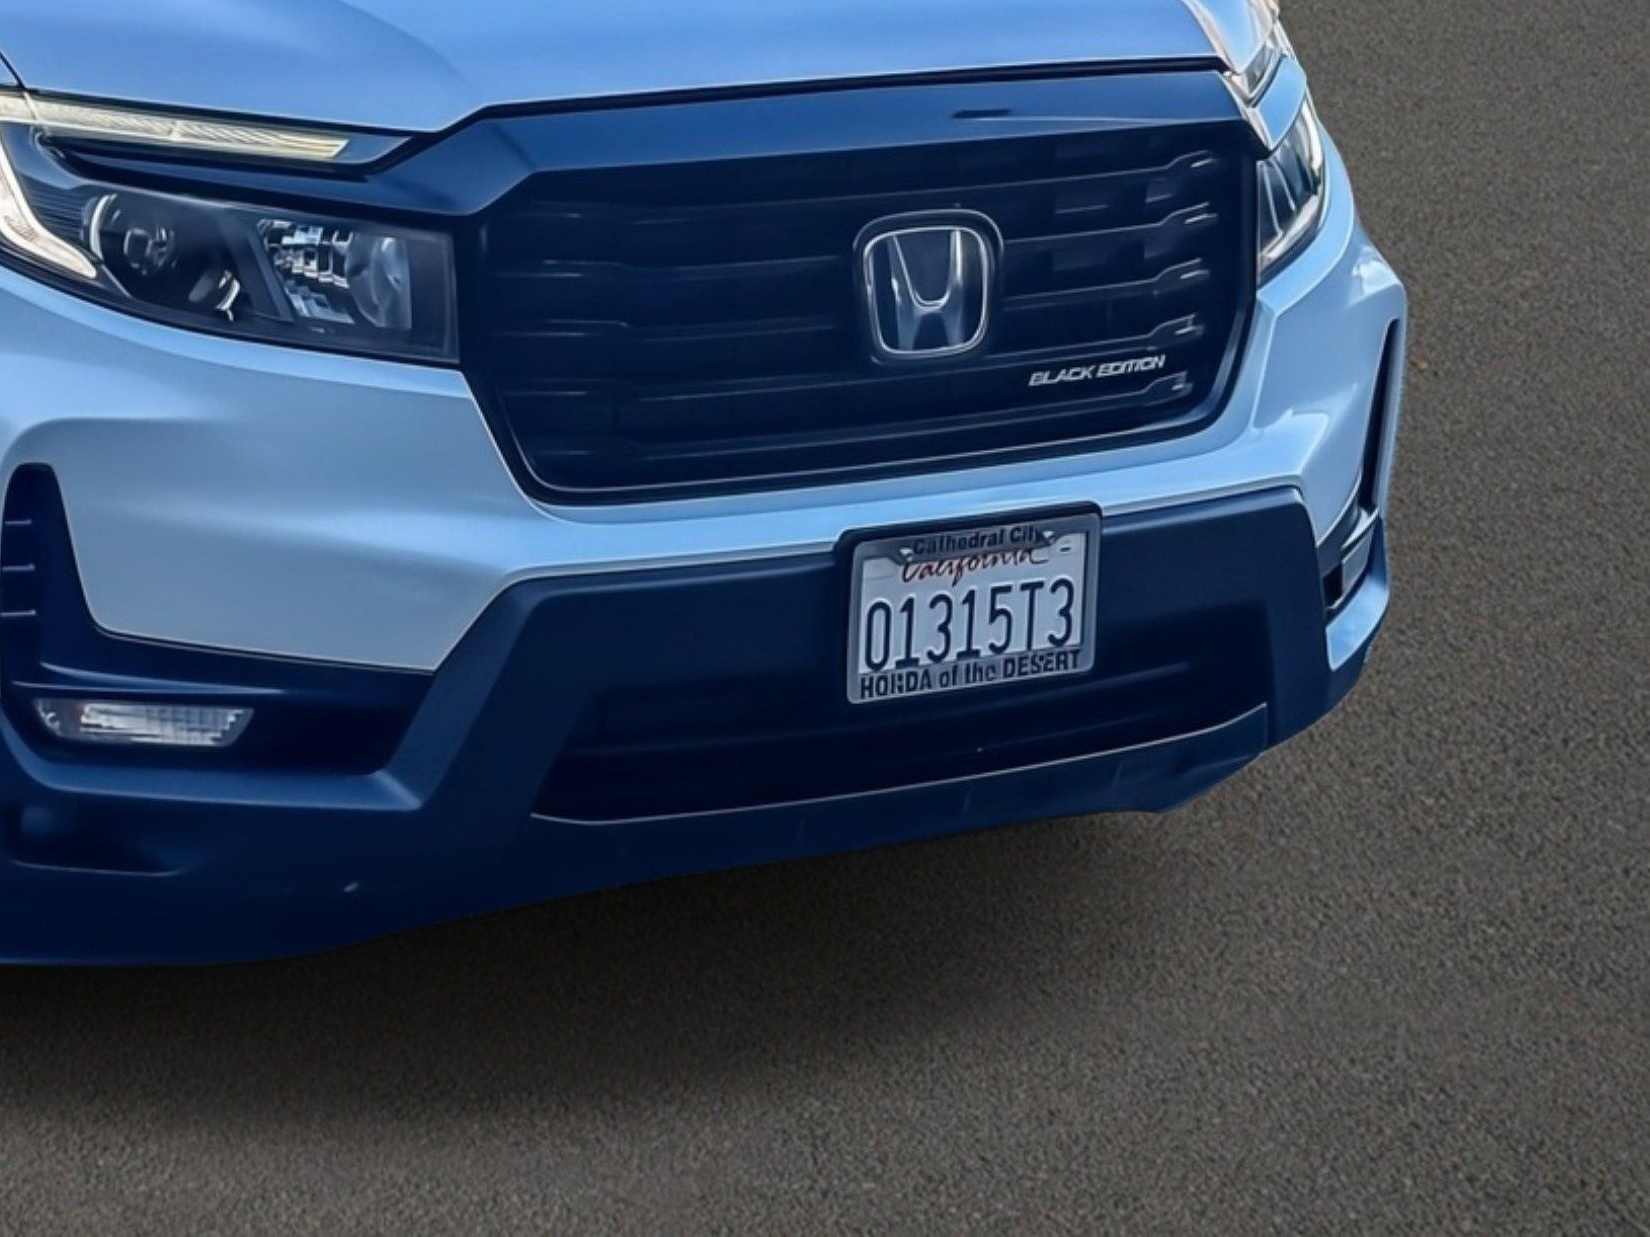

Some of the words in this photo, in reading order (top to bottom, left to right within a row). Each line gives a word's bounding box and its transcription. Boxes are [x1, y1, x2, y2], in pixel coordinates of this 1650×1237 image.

[1028, 364, 1096, 386] BLACK
[1095, 354, 1166, 378] EDITION
[913, 527, 1004, 555] Cathedral
[1010, 524, 1043, 545] City
[901, 548, 1049, 587] California
[864, 577, 1075, 672] 01315T3
[860, 668, 932, 700] HONDA
[939, 664, 958, 688] of
[964, 661, 996, 684] the
[1003, 648, 1081, 678] DESERT
